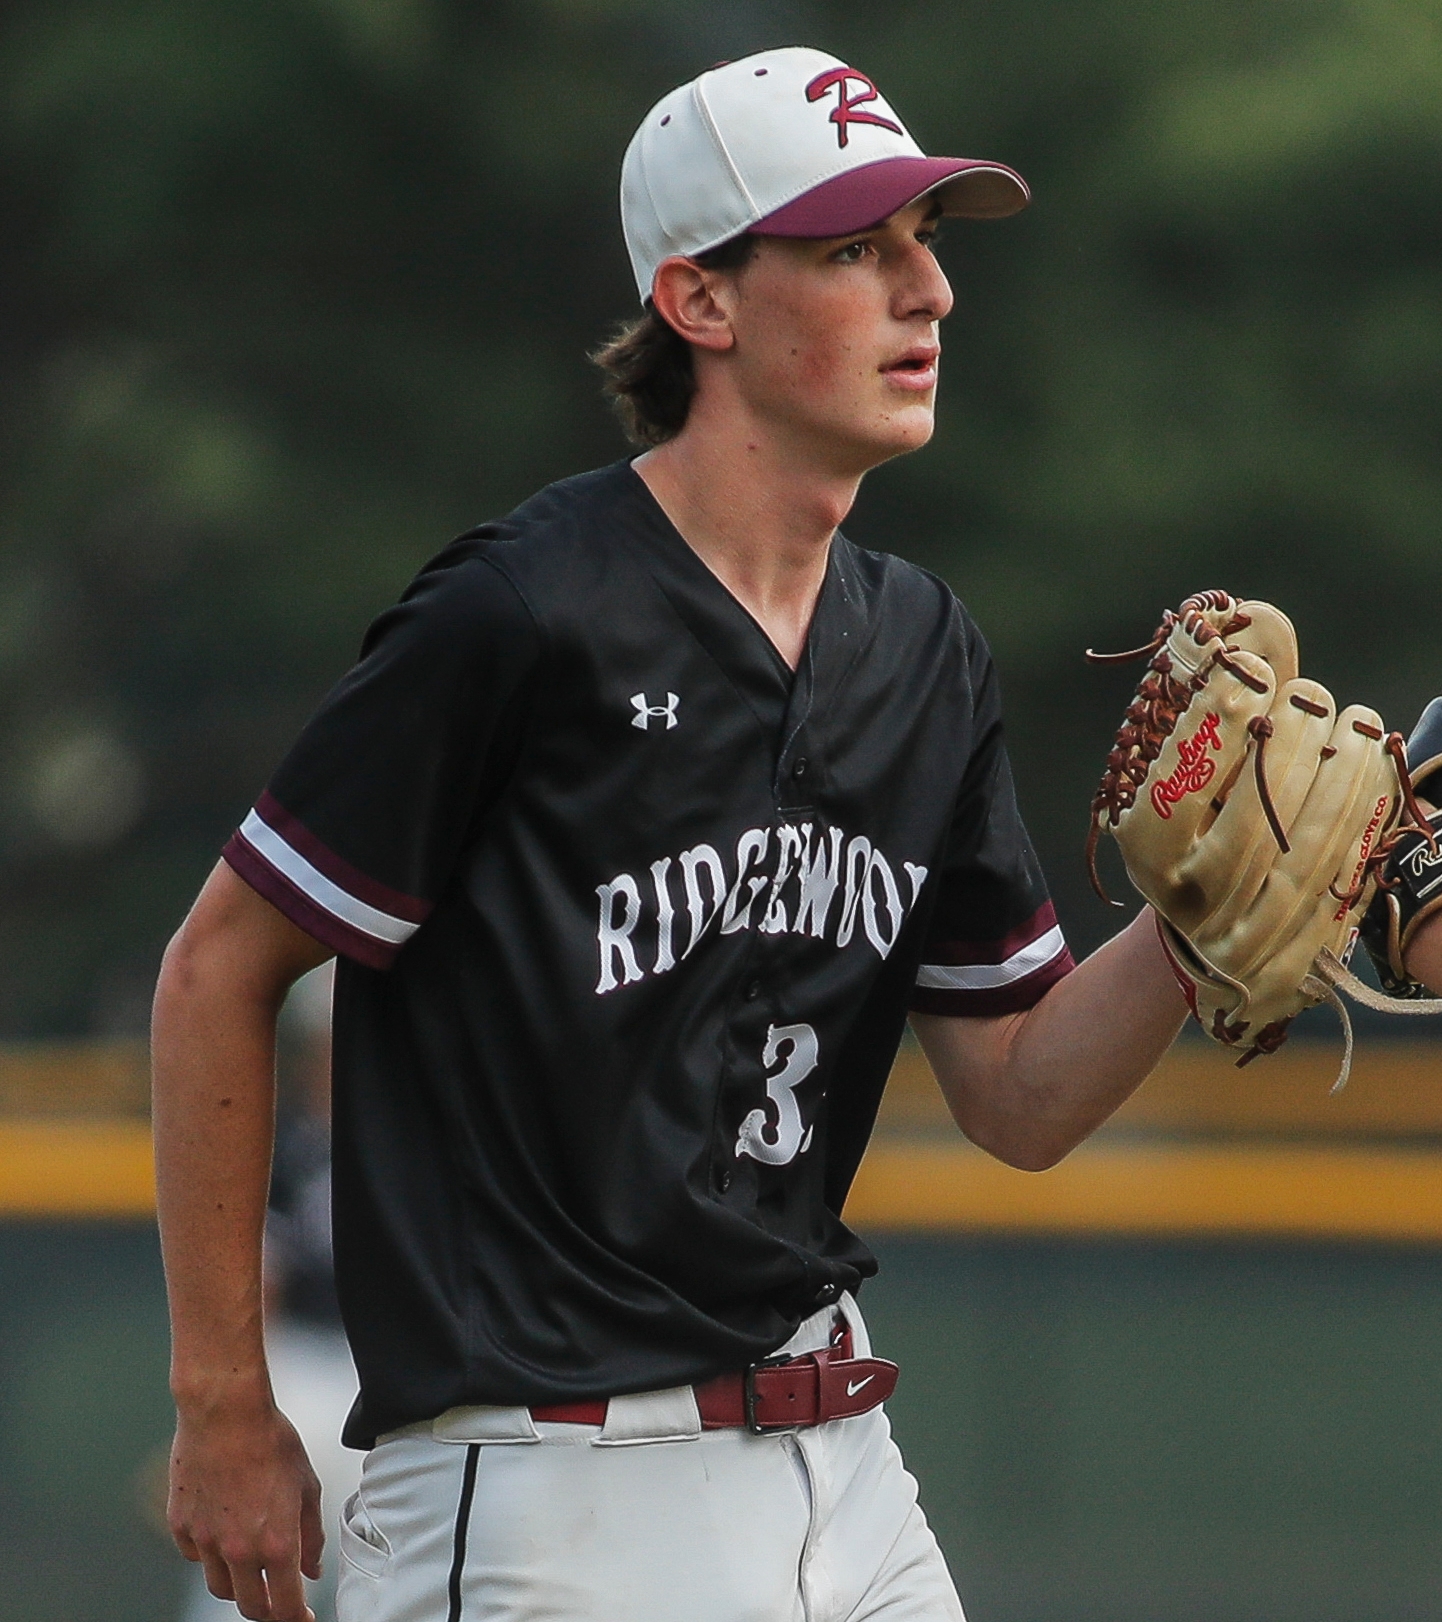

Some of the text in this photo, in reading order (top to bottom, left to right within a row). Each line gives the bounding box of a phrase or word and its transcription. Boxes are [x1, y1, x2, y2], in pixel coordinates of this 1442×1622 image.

[805, 66, 903, 149] R
[1150, 711, 1223, 820] Rawlings
[1360, 817, 1380, 860] GLOVE
